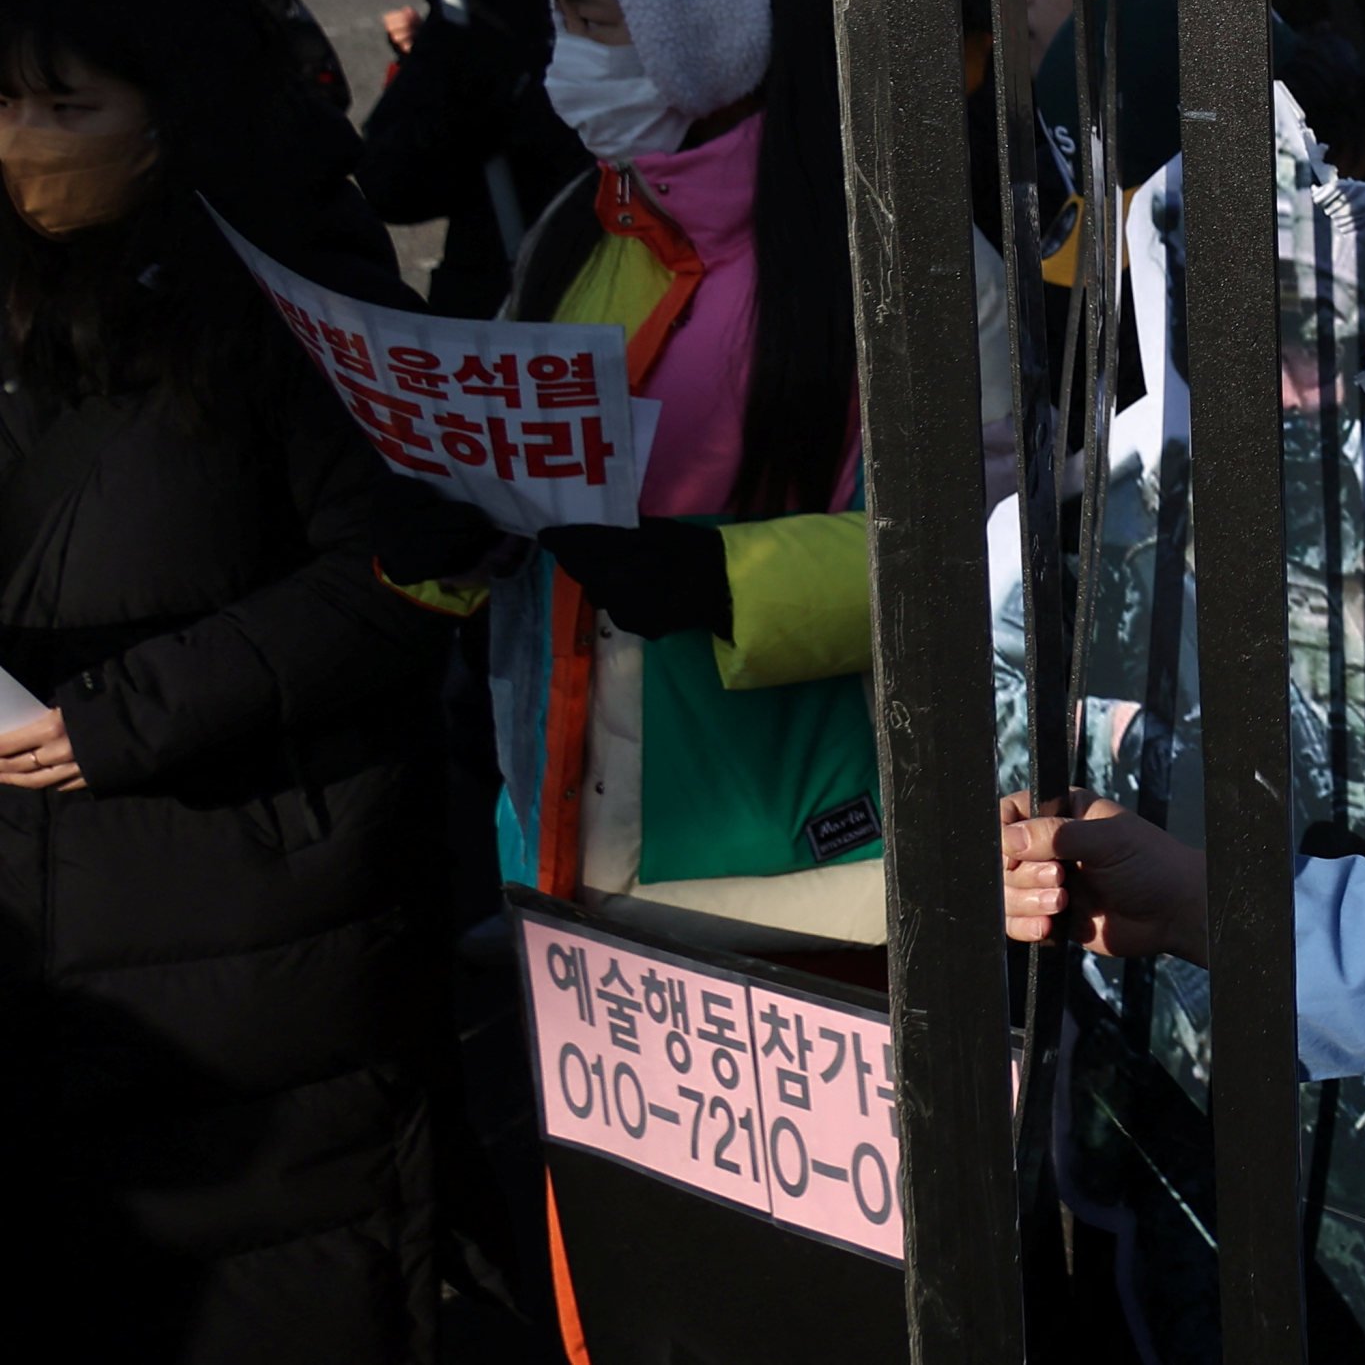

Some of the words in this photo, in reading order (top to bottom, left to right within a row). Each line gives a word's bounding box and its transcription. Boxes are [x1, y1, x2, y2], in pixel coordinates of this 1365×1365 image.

[387, 345, 599, 409] 윤석열
[546, 941, 748, 1090] 예술행동
[558, 1041, 900, 1226] 010-7210-0
